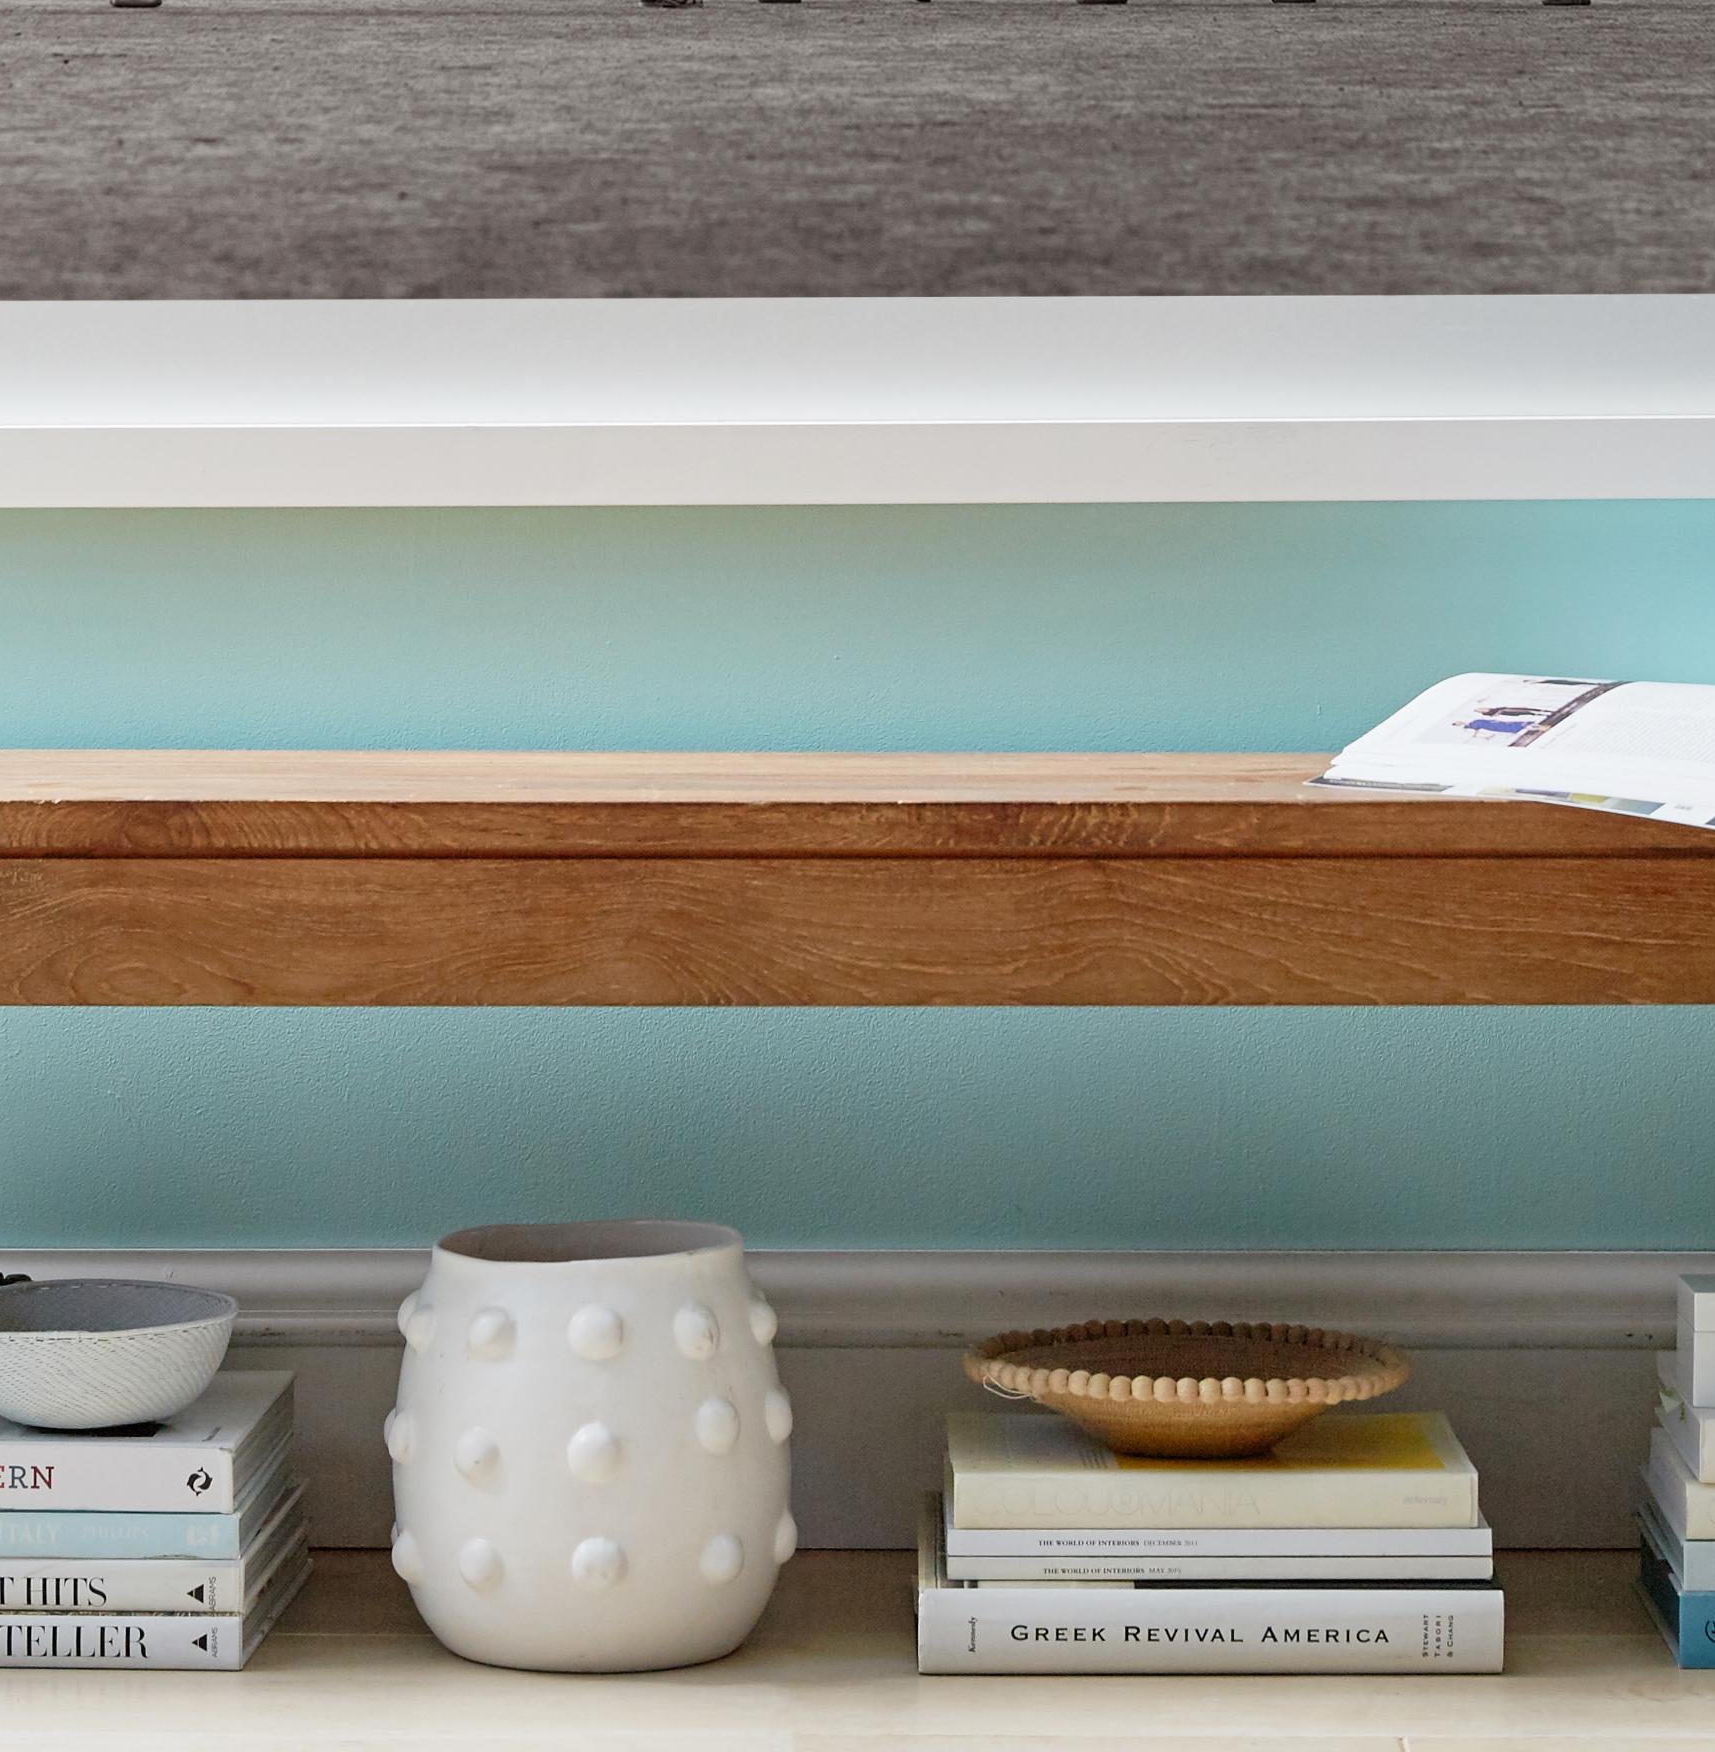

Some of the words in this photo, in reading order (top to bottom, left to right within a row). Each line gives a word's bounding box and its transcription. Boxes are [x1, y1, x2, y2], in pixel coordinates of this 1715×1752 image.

[1038, 1539, 1053, 1547] THE
[1056, 1539, 1084, 1547] WORLD
[1085, 1539, 1096, 1547] OF
[1098, 1539, 1140, 1547] INTERIORS
[1043, 1567, 1058, 1575] THE
[1061, 1567, 1089, 1575] WORLD
[1090, 1567, 1101, 1575] OF
[1103, 1567, 1145, 1575] INTERIORS
[1148, 1567, 1165, 1575] MAY
[23, 1576, 108, 1607] HITS
[210, 1626, 218, 1658] ABRAMS
[1010, 1624, 1107, 1643] GREEK
[1124, 1625, 1245, 1643] REVIVAL
[1260, 1626, 1390, 1644] AMERICA
[1434, 1615, 1442, 1658] TABORI
